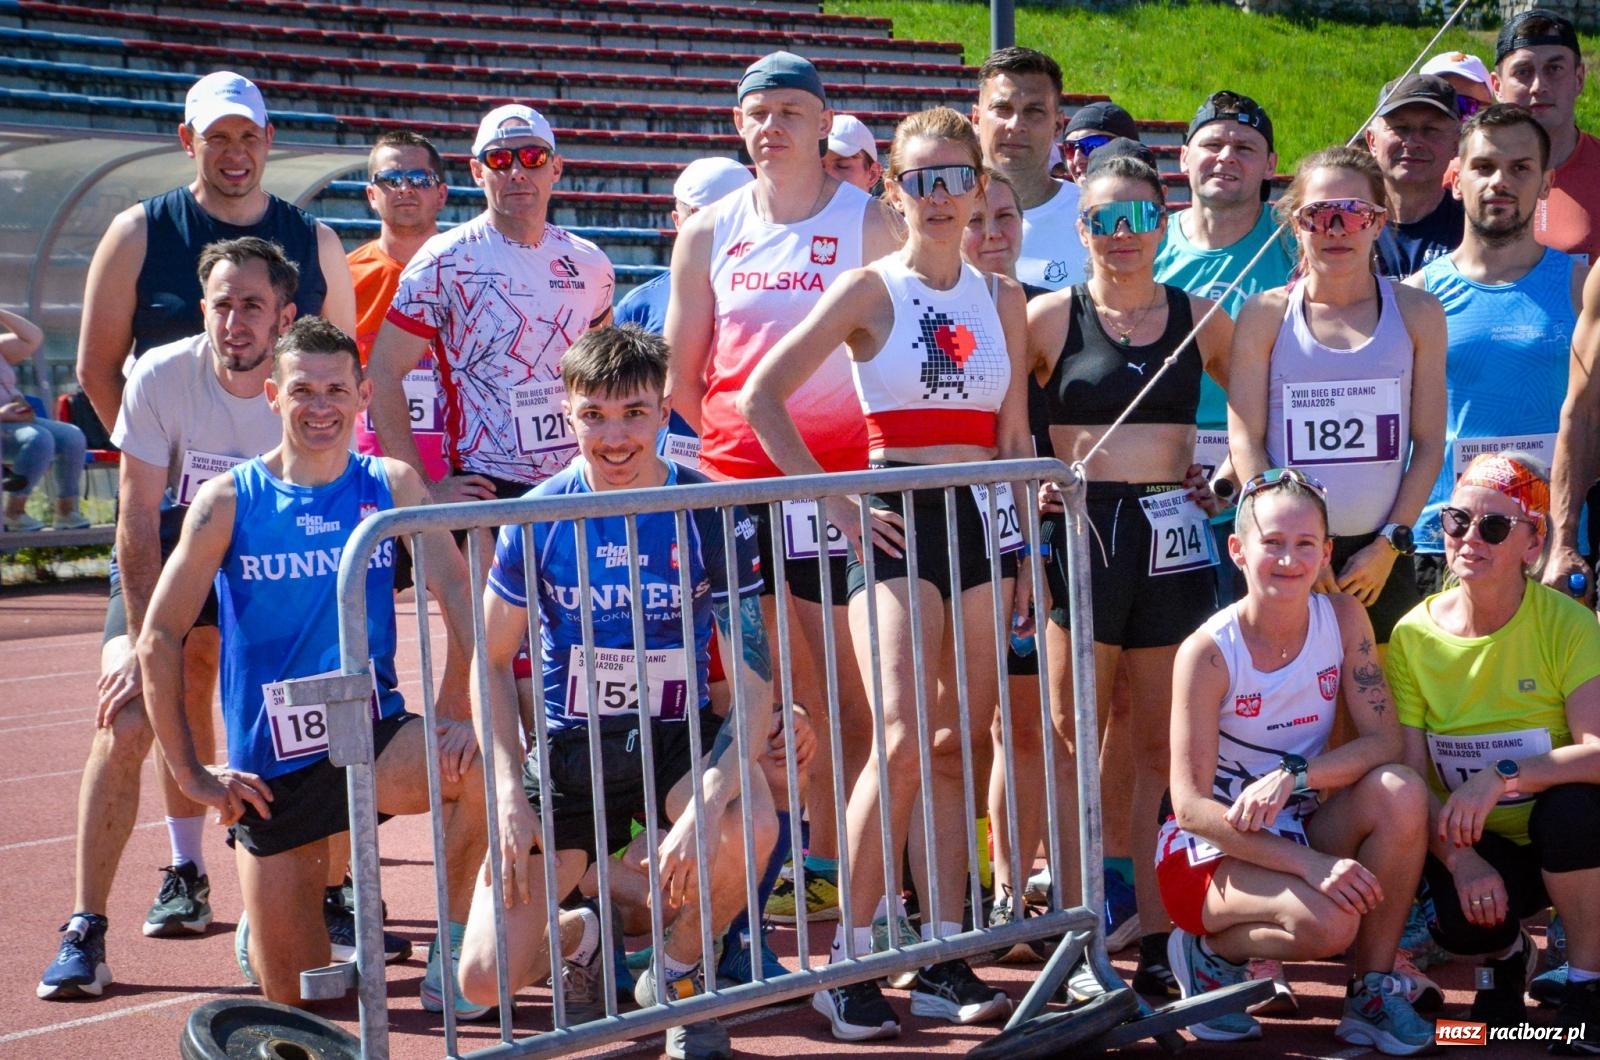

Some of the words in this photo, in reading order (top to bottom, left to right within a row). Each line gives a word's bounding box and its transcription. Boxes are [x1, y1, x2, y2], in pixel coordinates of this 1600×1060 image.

[571, 281, 586, 289] TEAM
[731, 272, 825, 292] POLSKA
[529, 388, 544, 398] BIEG
[544, 386, 555, 395] BEZ
[554, 385, 565, 394] GRA
[1291, 389, 1309, 399] XVIII
[1311, 388, 1329, 398] BIEG
[1331, 387, 1345, 397] BEZ
[1347, 386, 1376, 396] GRANIC
[516, 396, 549, 408] 3MAJA2026
[1291, 398, 1336, 409] 3MAJA2026
[532, 412, 566, 442] 121
[1202, 435, 1229, 445] GRANIC
[1304, 417, 1366, 452] 182
[670, 448, 698, 458] 3MAJA20
[1461, 444, 1479, 454] XVIII
[1481, 442, 1499, 452] BIEG
[1516, 440, 1544, 451] GRANIC
[191, 462, 231, 473] 3MAJA202
[211, 459, 228, 467] BIEG
[1172, 495, 1182, 507] BEZ
[1165, 524, 1202, 559] 214
[239, 540, 394, 581] RUNNRS
[600, 653, 619, 662] BIEG
[620, 654, 635, 663] BEZ
[644, 655, 667, 663] ANIC
[578, 659, 624, 671] 3JA2026
[287, 710, 326, 742] 18
[1436, 740, 1454, 750] XVIII
[1455, 741, 1474, 750] BIEG
[1476, 741, 1490, 750] BEZ
[1492, 738, 1523, 749] GRANIC
[1437, 748, 1482, 758] 3MAJA2026
